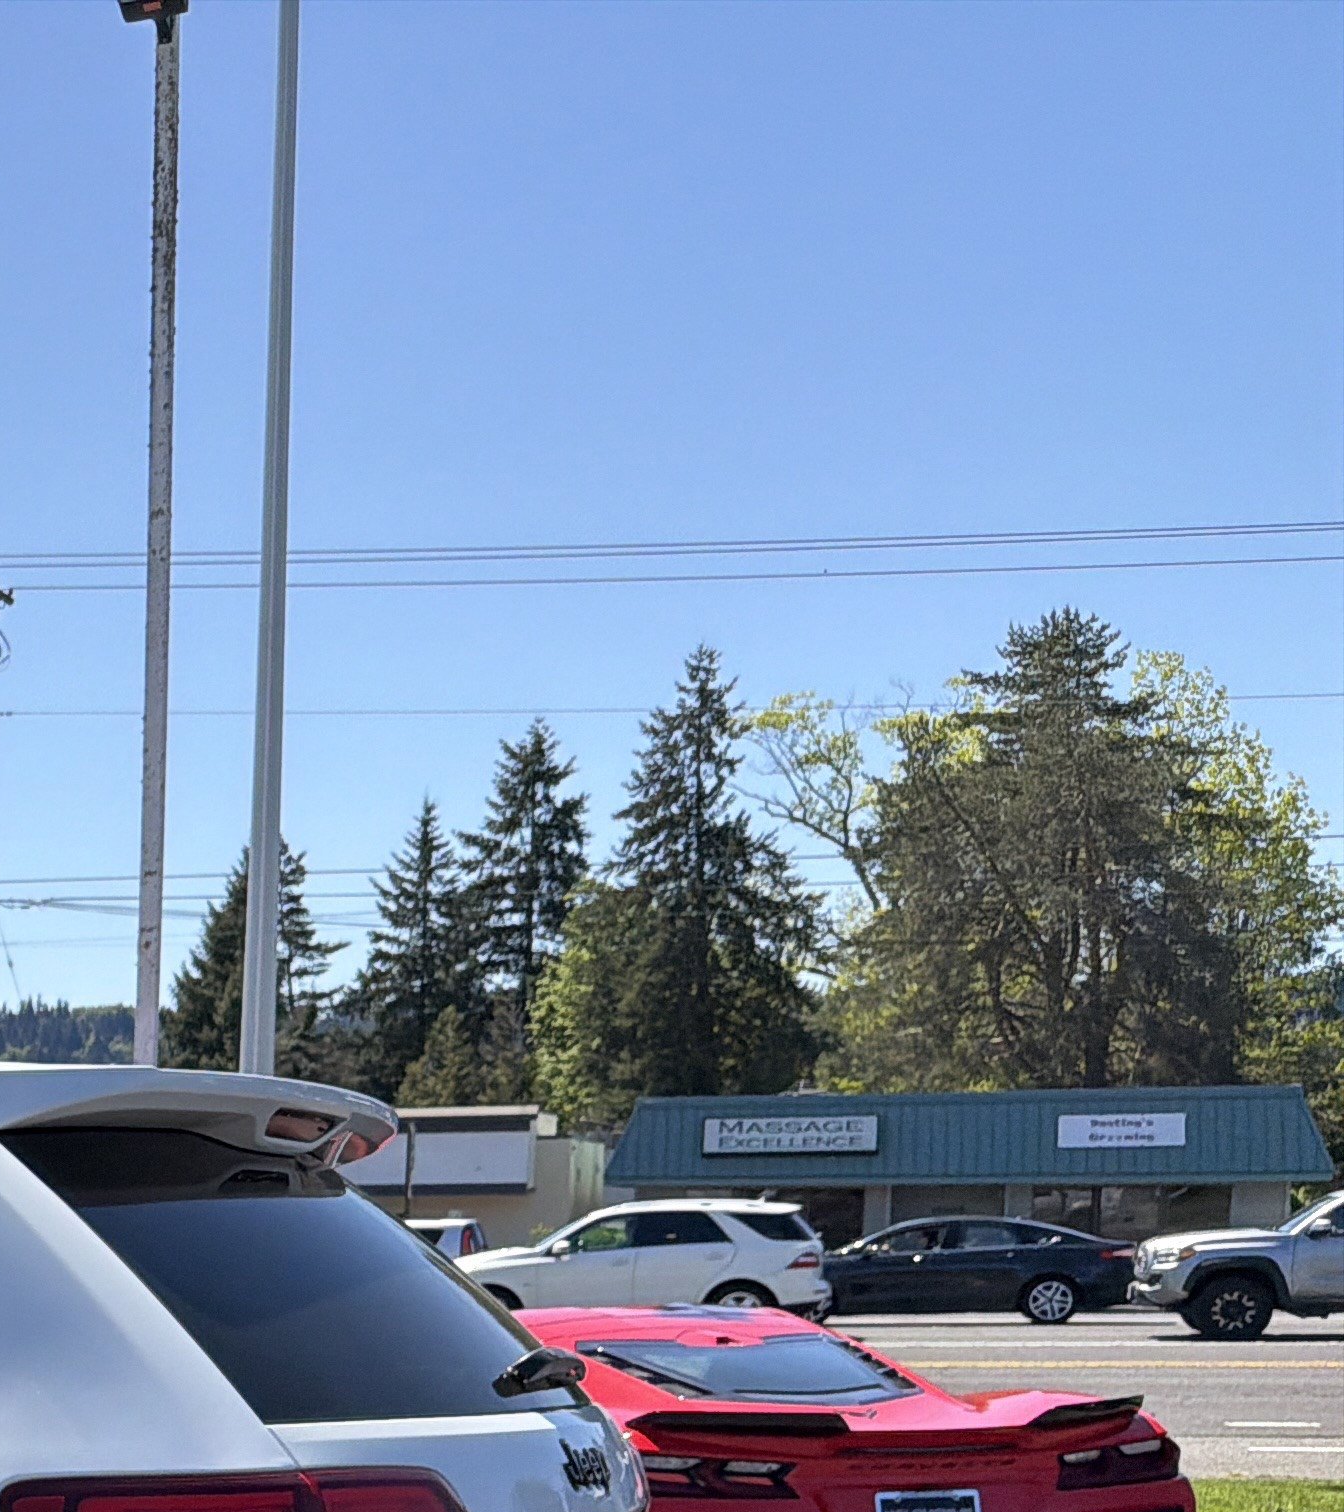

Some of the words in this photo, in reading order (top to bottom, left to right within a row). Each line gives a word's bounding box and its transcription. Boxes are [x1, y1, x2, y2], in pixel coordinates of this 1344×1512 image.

[717, 1119, 864, 1135] MASSAGE
[718, 1135, 863, 1149] EXCELLENCE
[559, 1438, 611, 1498] Jeep
